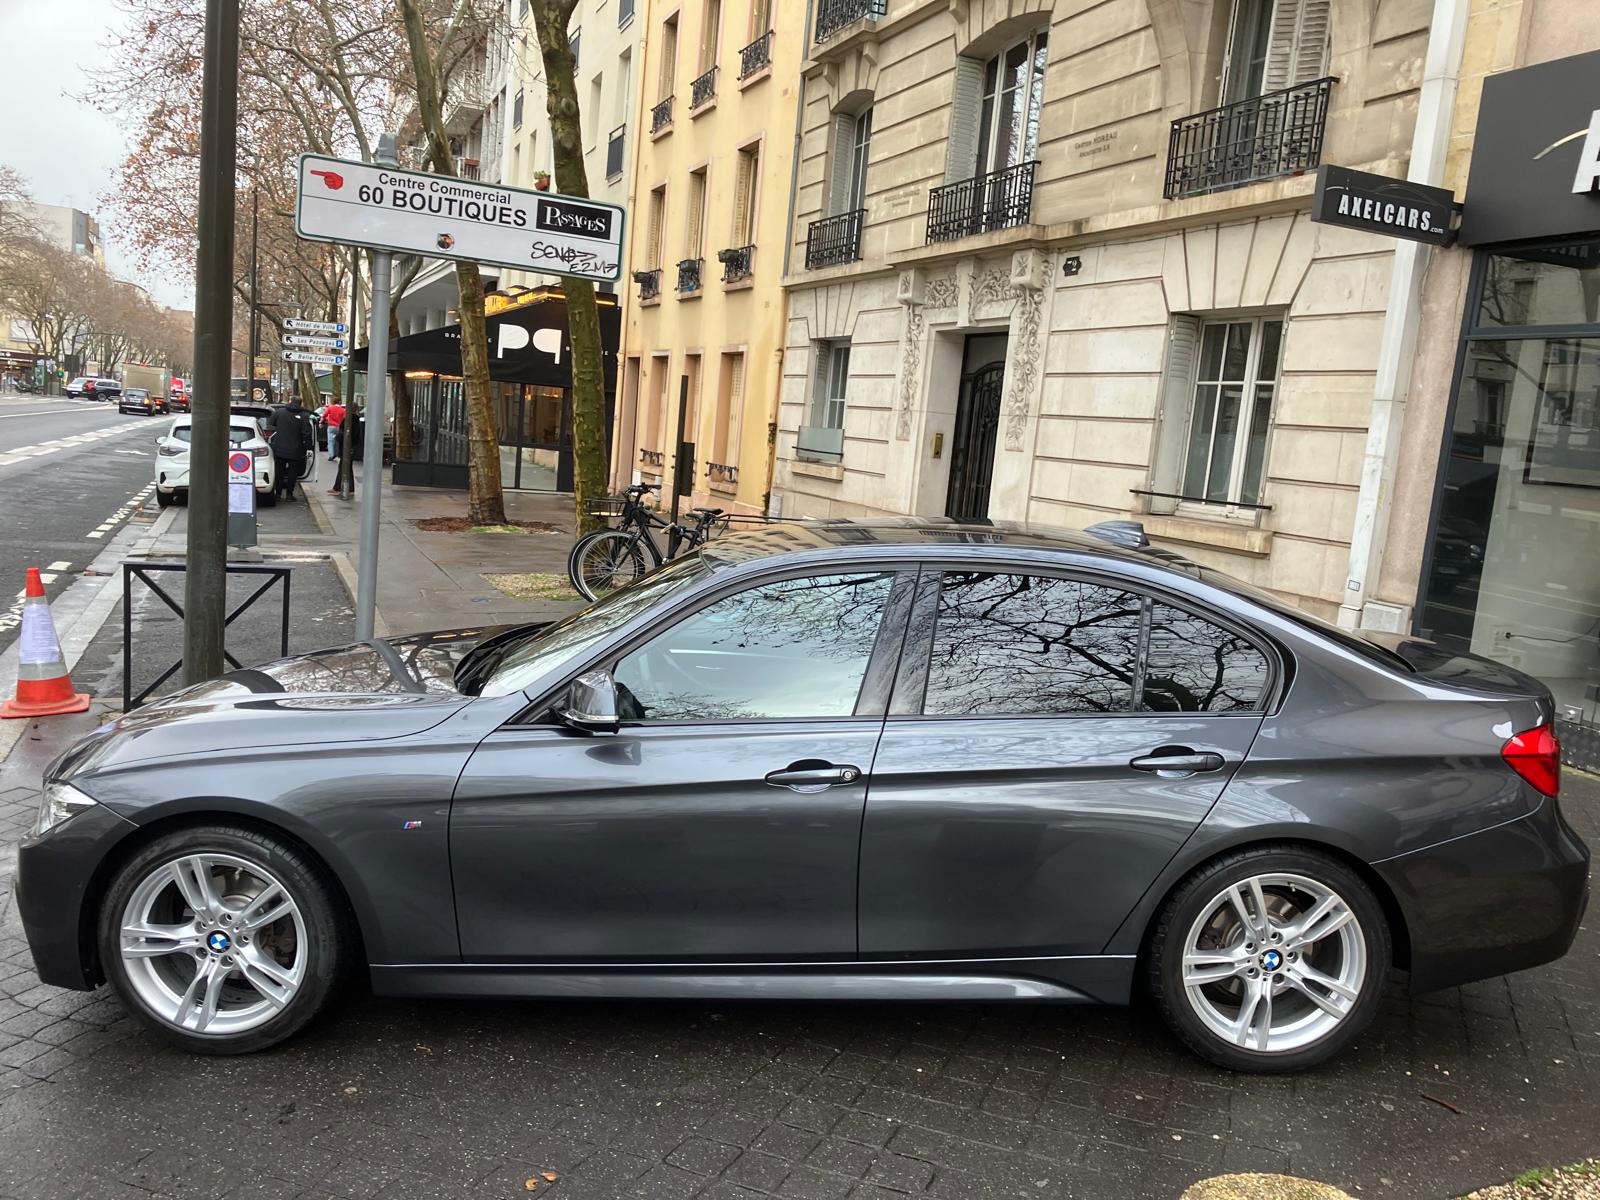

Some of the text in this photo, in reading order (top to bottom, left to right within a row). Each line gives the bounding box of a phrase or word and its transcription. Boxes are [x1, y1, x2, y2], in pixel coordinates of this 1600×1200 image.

[378, 173, 511, 204] Centre Commercial
[358, 185, 527, 227] 60 BOUTIQUES
[1338, 194, 1431, 231] AXELCARS
[309, 339, 335, 347] Passages
